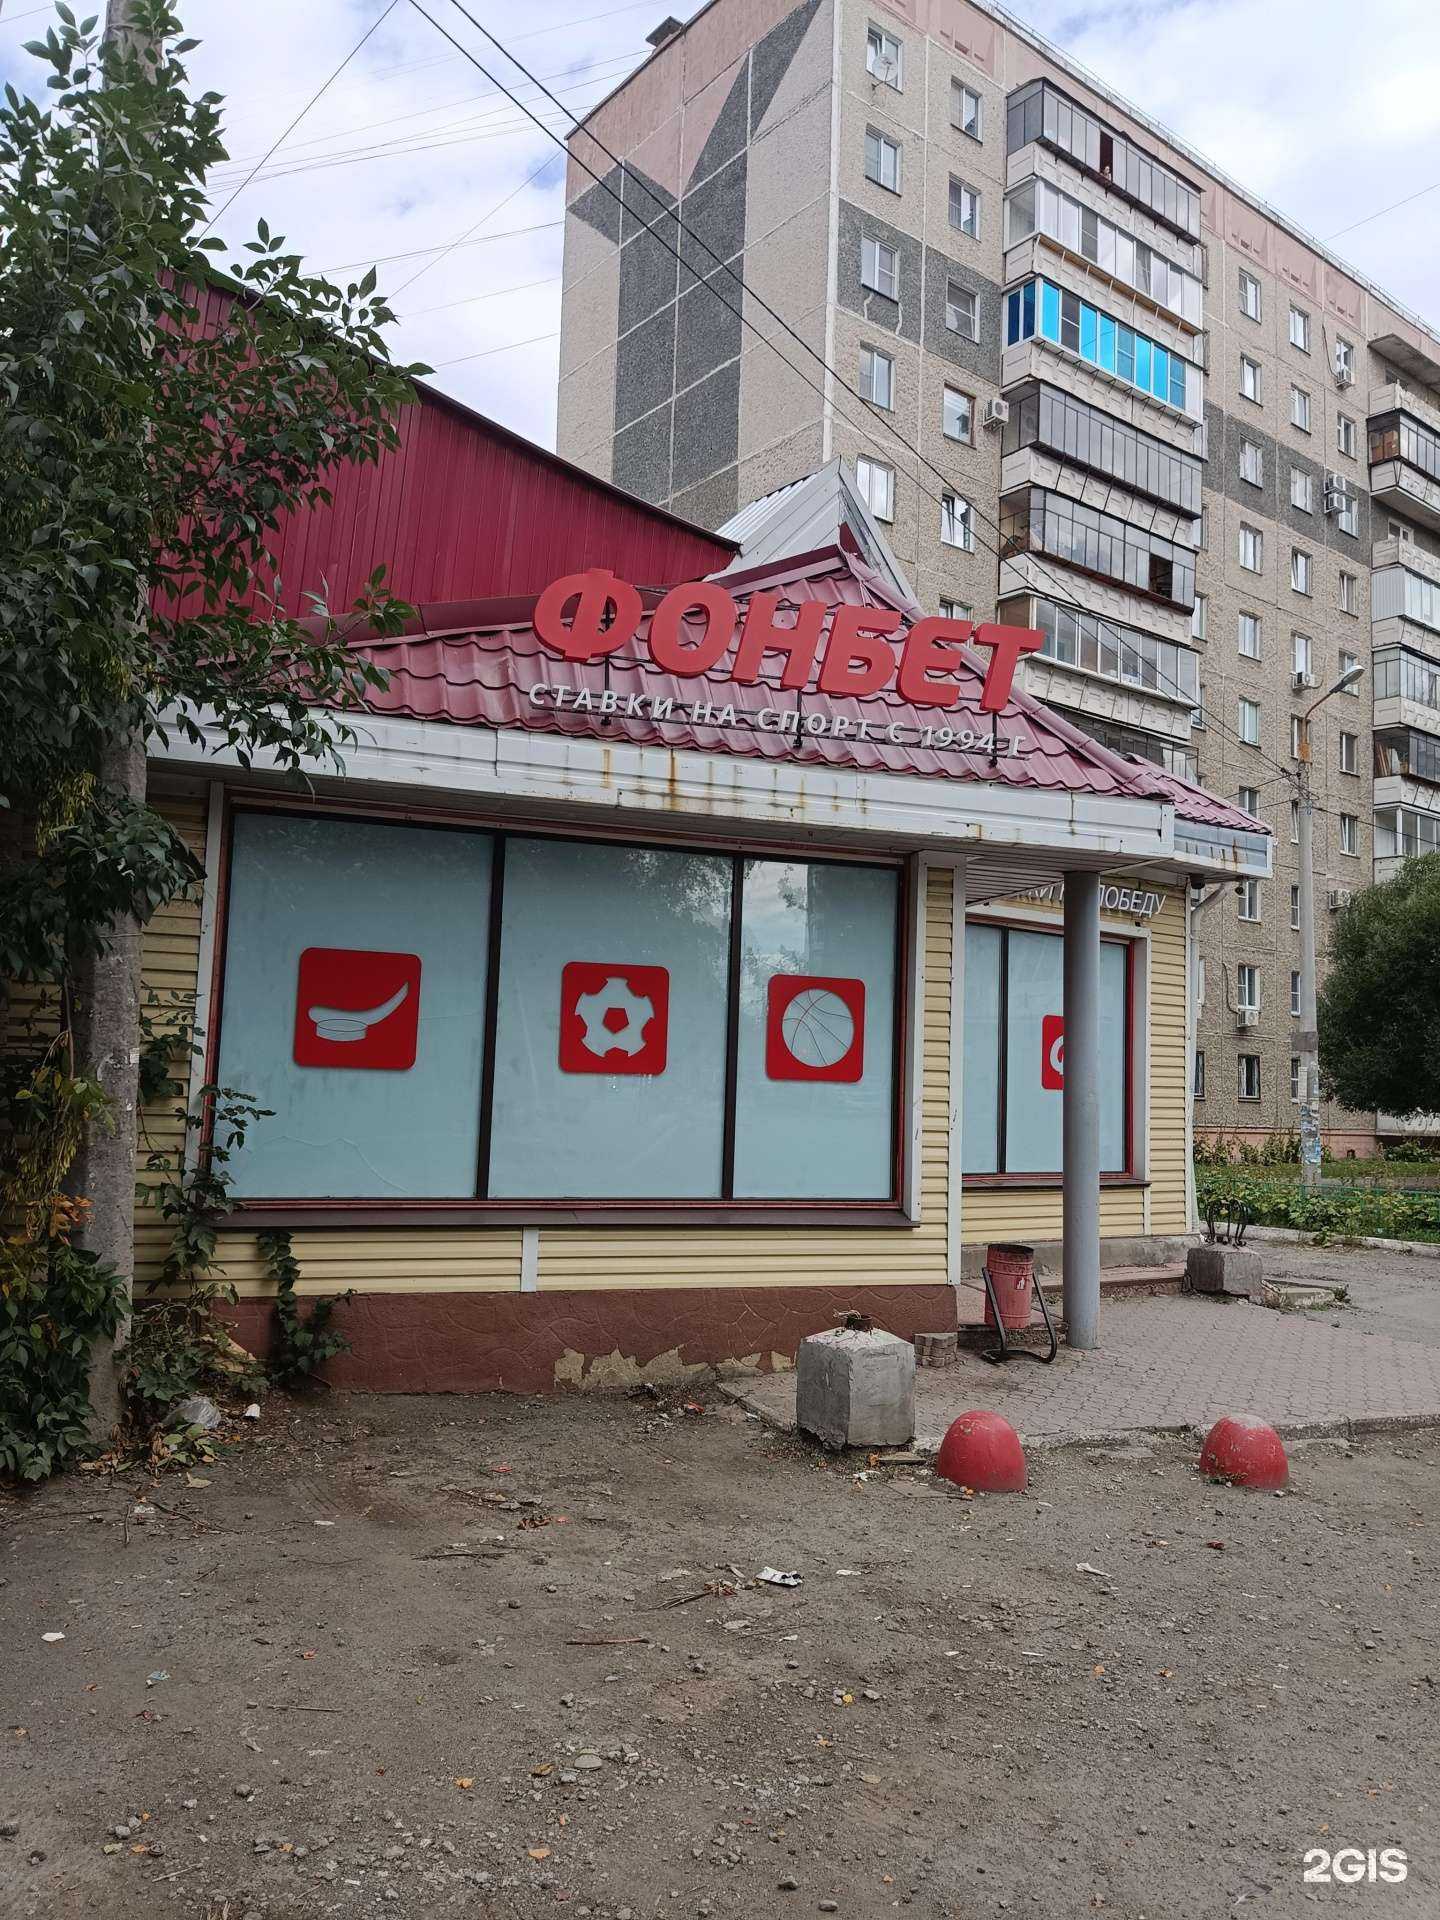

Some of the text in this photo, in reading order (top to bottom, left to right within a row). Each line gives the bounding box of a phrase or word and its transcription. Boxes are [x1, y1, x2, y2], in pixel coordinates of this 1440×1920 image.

[533, 568, 1045, 713] ФОНБЕТ
[528, 682, 1027, 758] СТАВКИ НА СПОРТ С 1994 Г
